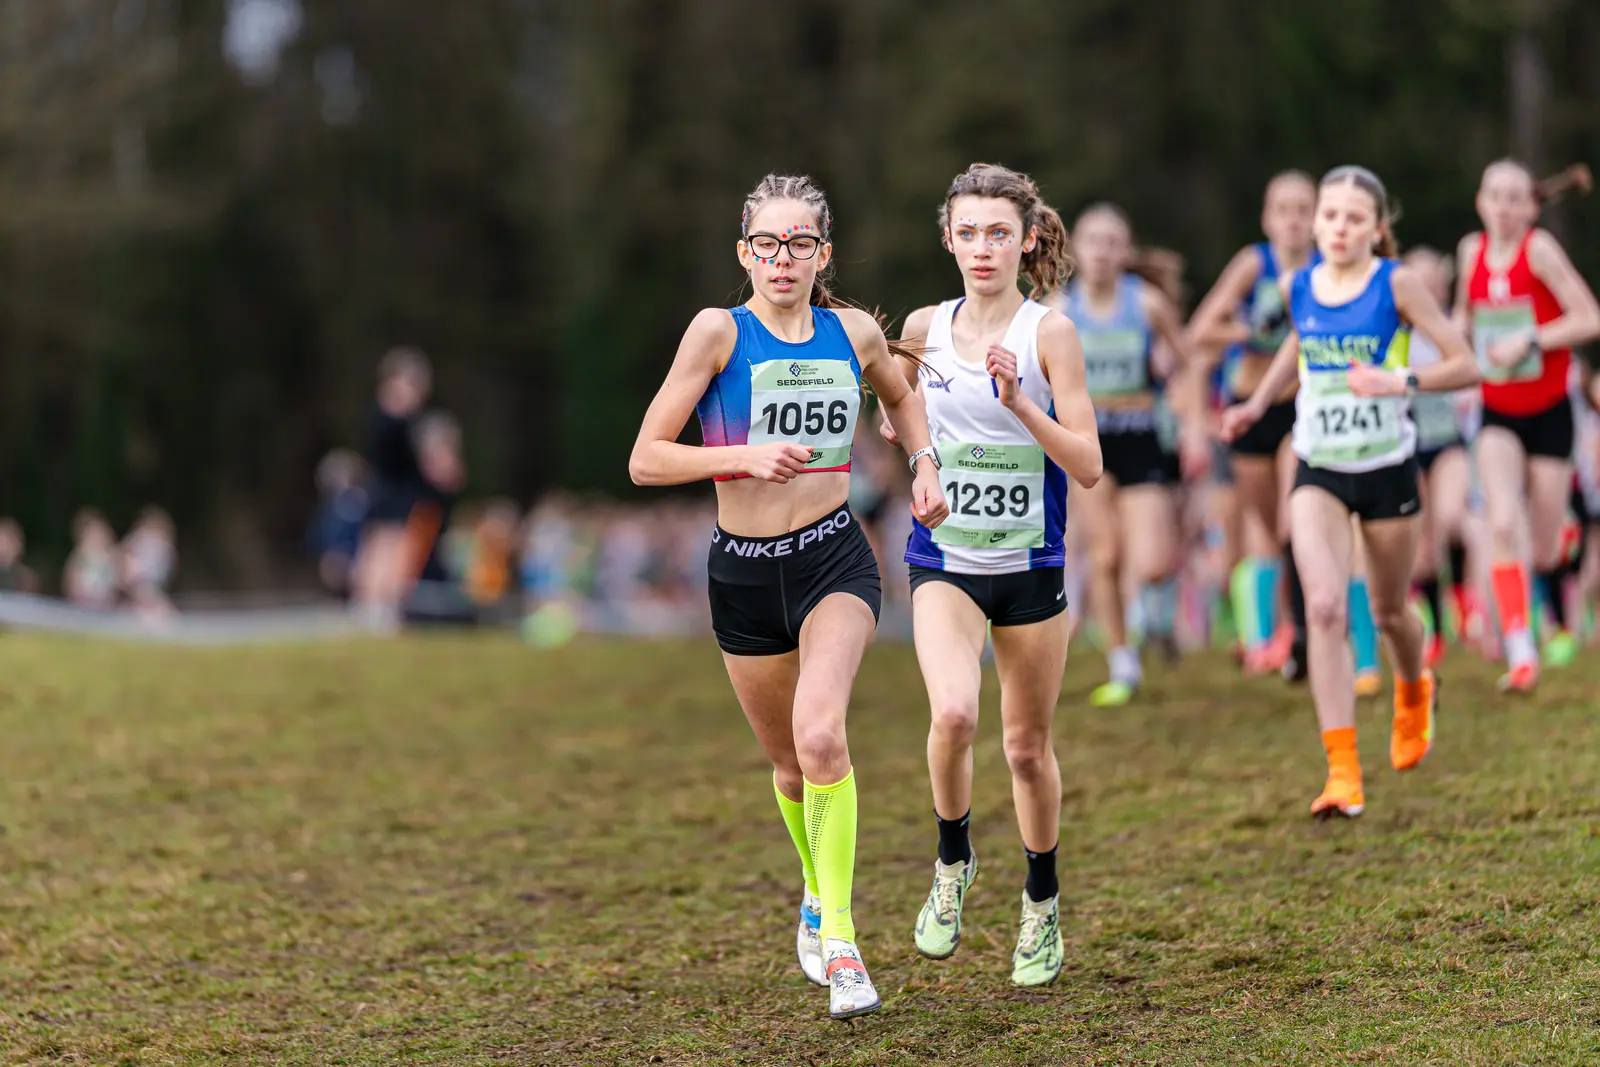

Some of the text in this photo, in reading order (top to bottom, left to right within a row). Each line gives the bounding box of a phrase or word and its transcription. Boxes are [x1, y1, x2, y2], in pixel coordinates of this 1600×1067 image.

[776, 378, 834, 386] SEDGEFIELD
[762, 399, 848, 436] 1056
[1316, 403, 1382, 435] 1241
[810, 451, 824, 459] RUN
[958, 459, 1019, 470] SEDGEFIELD
[946, 481, 1030, 518] 1239
[724, 510, 850, 558] NIKE PRO
[993, 531, 1008, 539] RUN
